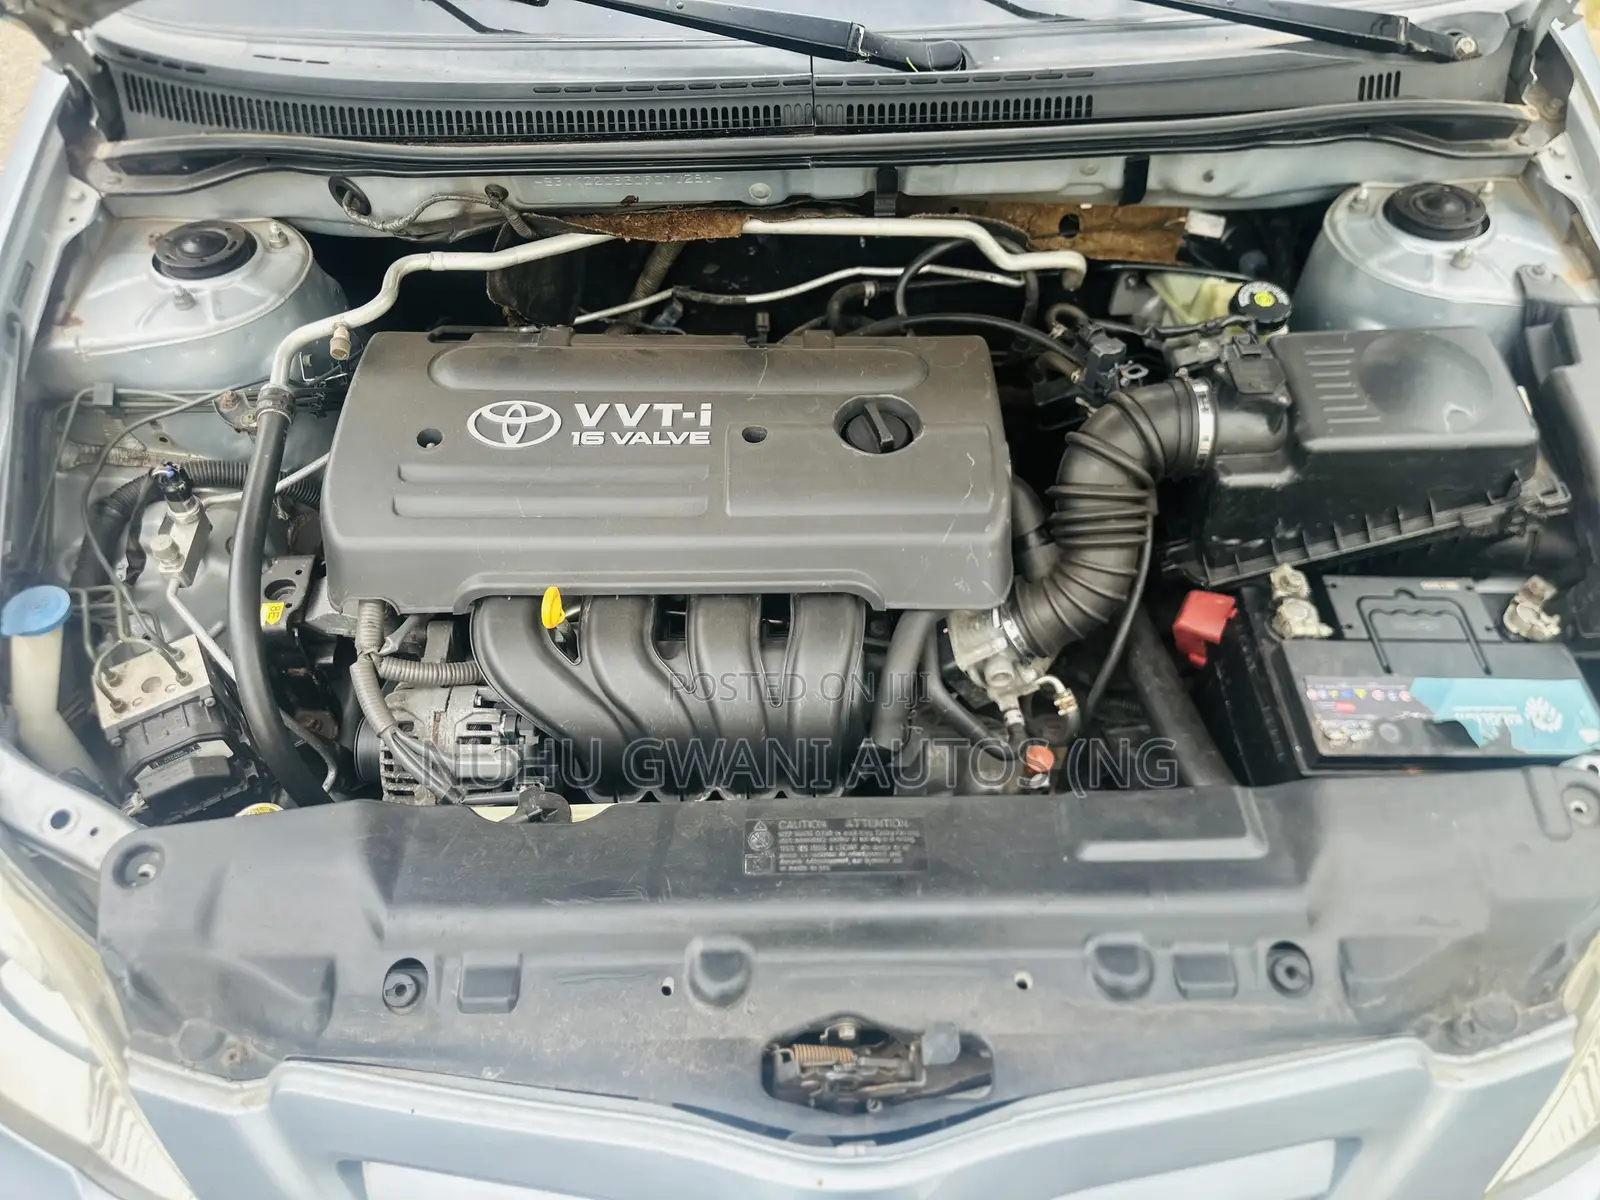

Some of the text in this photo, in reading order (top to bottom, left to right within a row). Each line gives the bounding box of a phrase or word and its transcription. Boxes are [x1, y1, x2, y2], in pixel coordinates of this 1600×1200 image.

[574, 403, 712, 427] VVT-i
[571, 431, 711, 445] 16 VALVE
[778, 818, 910, 830] CAUTION ATTENTION
